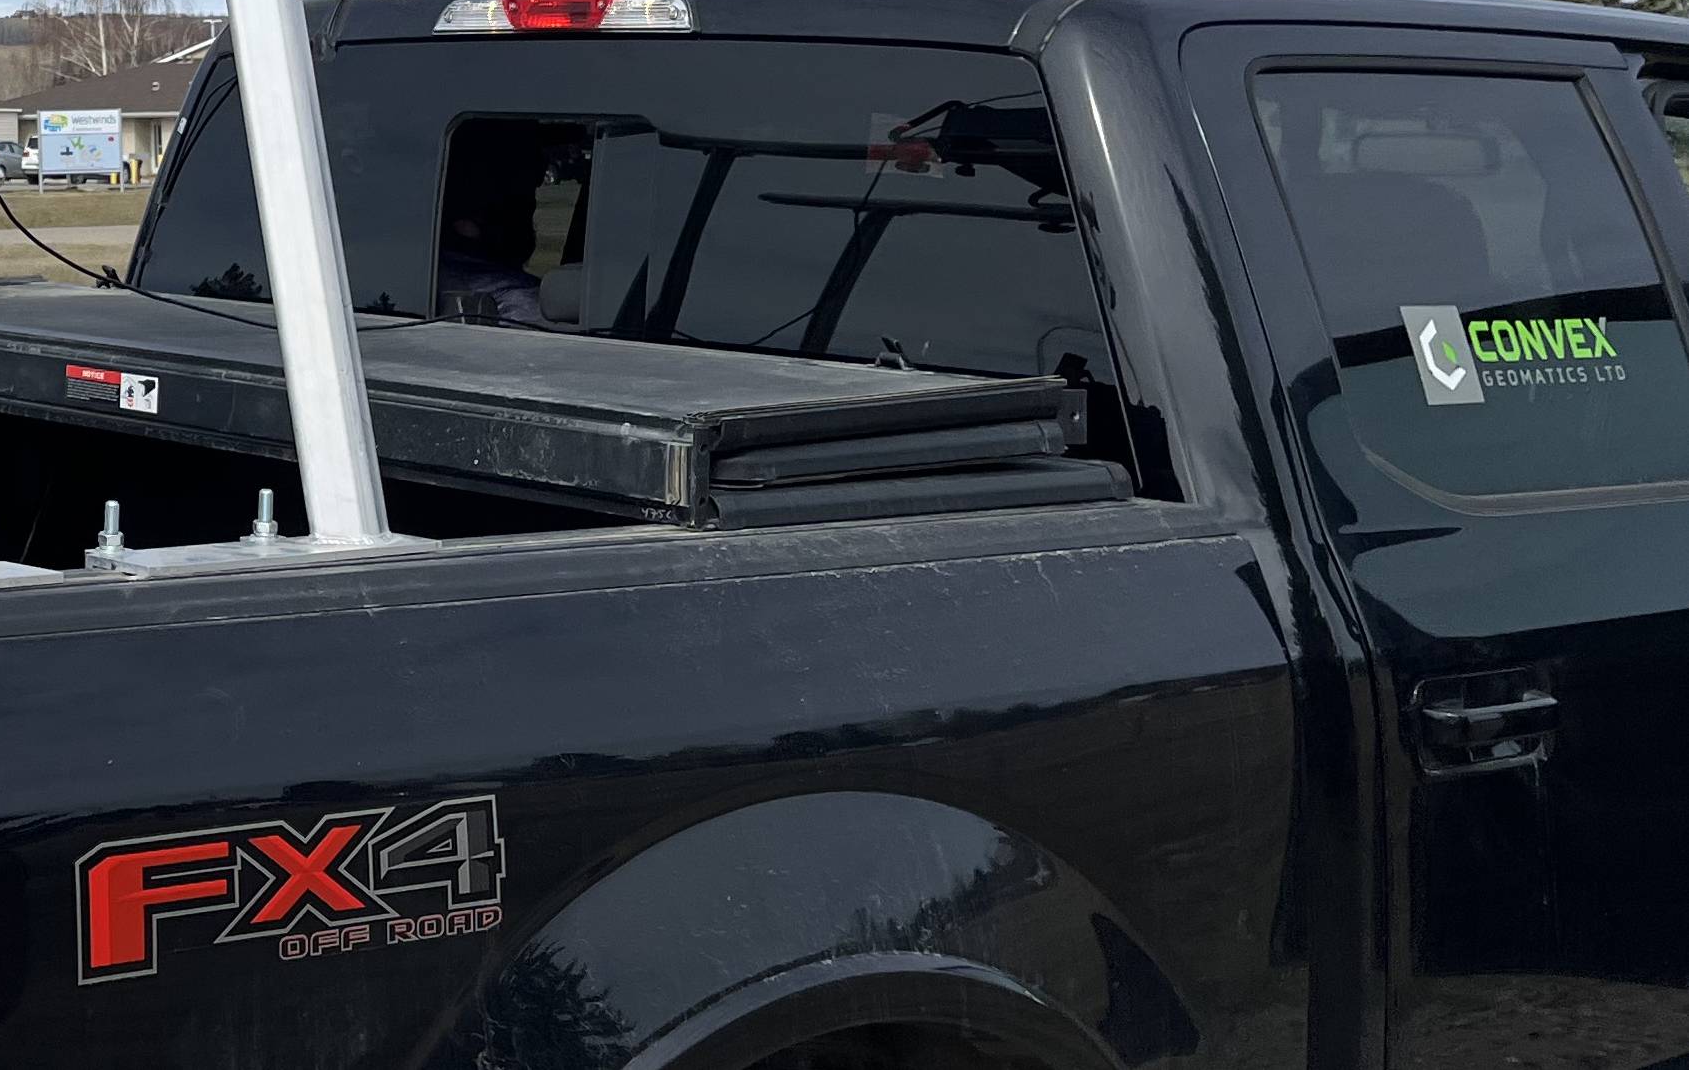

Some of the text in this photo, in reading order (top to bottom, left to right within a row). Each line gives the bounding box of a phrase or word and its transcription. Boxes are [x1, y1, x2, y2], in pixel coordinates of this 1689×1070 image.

[1468, 317, 1618, 362] CONVEX
[1482, 365, 1626, 387] GEOMATICS LTD
[76, 794, 506, 986] FX4
[279, 905, 502, 961] OFF ROAD
